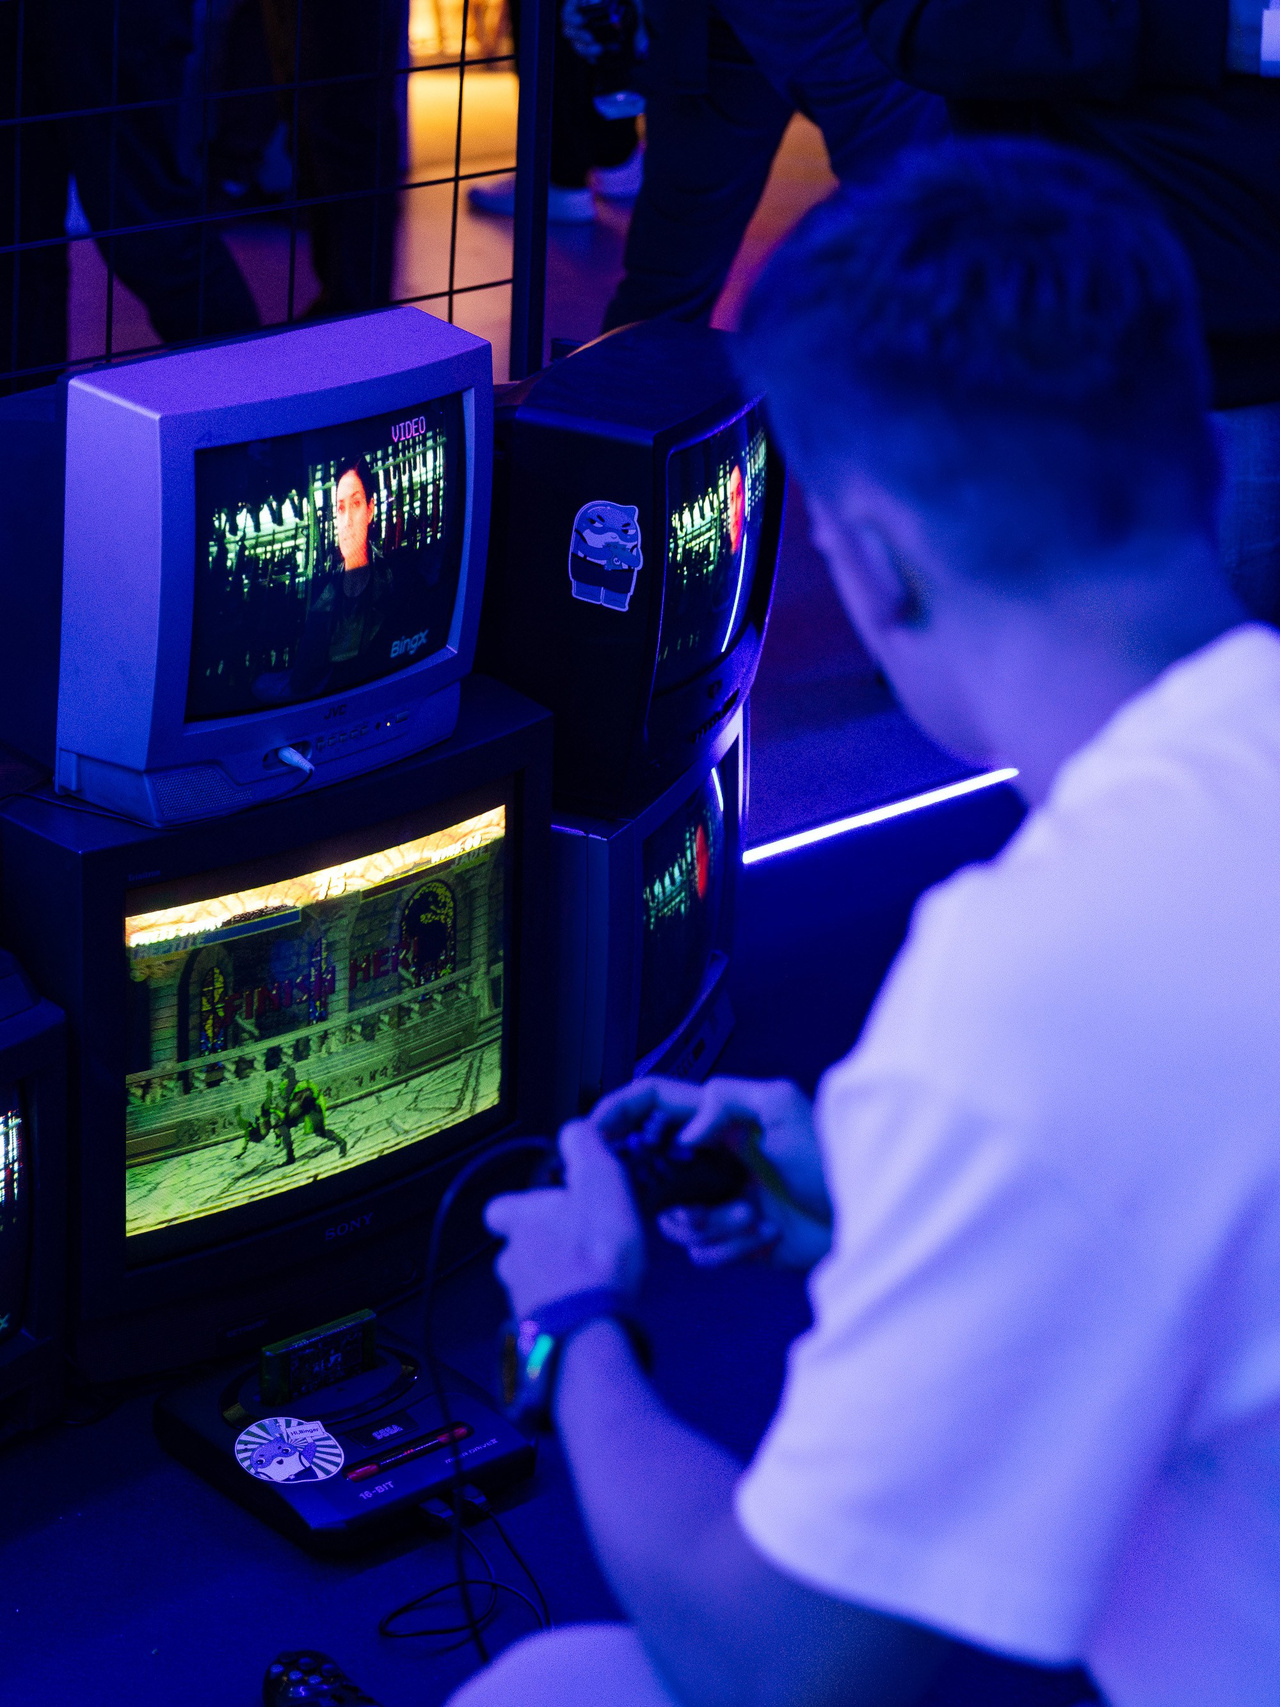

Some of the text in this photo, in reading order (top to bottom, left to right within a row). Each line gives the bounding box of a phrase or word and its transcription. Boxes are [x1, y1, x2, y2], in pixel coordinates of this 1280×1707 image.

[391, 415, 427, 443] VIDEO
[323, 703, 347, 720] JVC
[220, 966, 335, 1028] FINISH
[324, 1211, 375, 1242] SONY
[358, 1480, 395, 1501] 16-BIT
